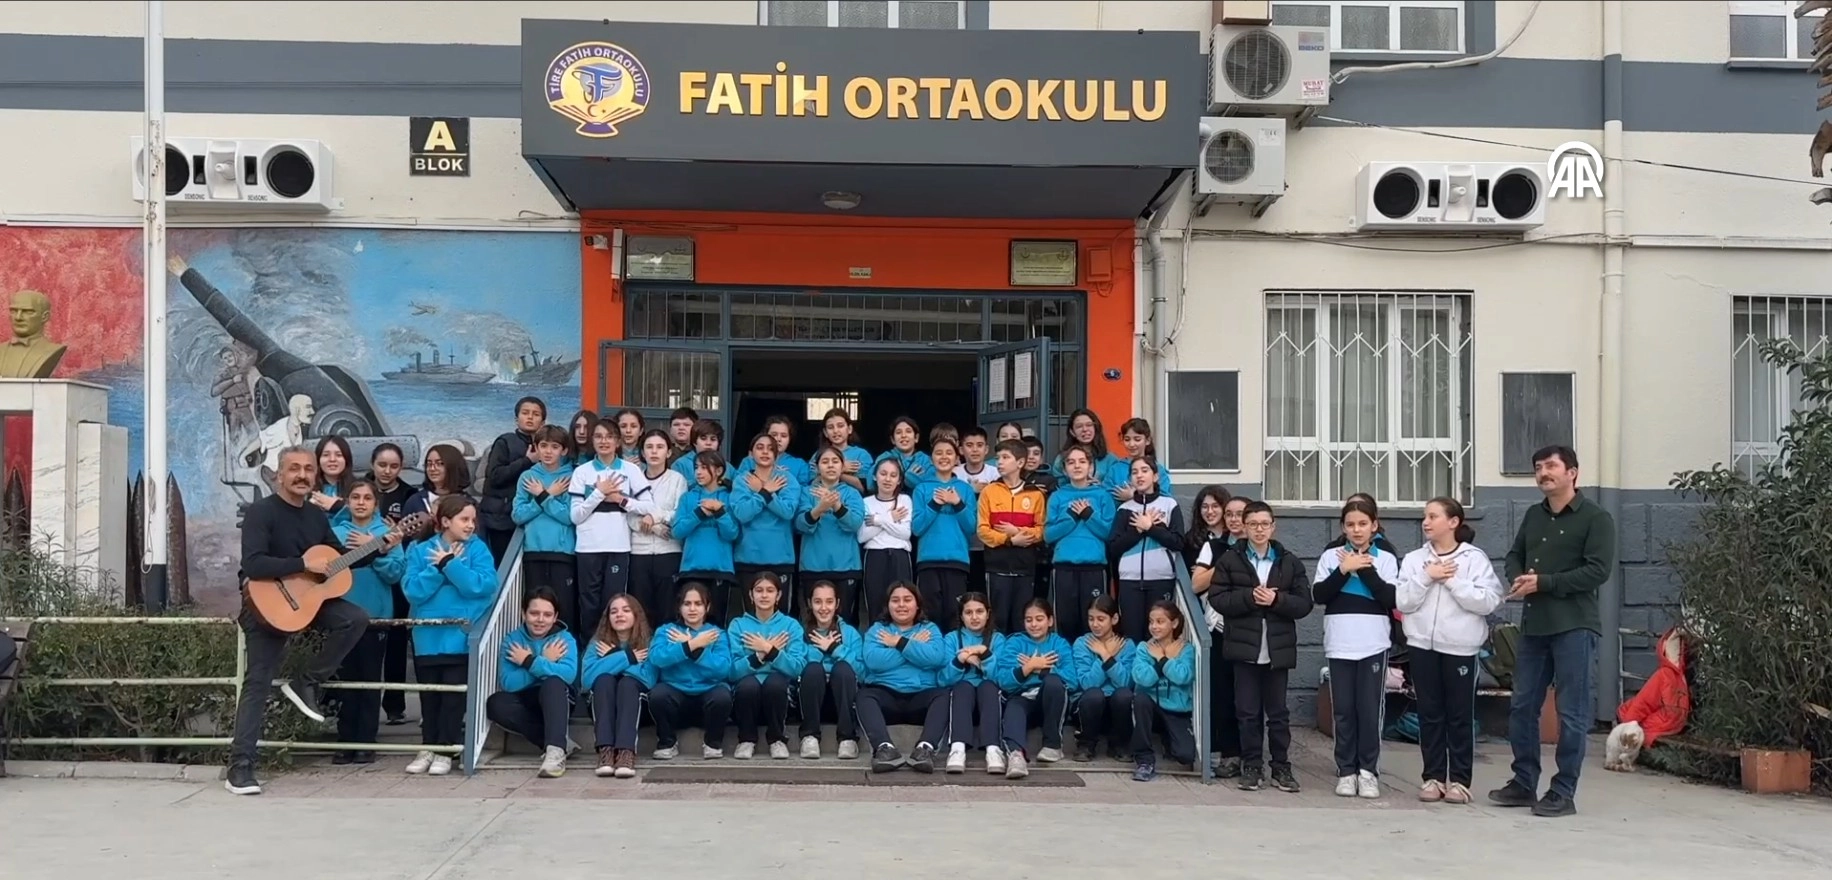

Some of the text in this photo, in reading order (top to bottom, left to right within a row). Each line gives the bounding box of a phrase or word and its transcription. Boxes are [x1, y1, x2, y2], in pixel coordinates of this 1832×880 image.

[549, 47, 644, 97] TİRE FATİH ORTAOKULU
[679, 61, 1167, 121] FATİH ORTAOKULU
[423, 120, 457, 151] A
[415, 158, 464, 171] BLOK
